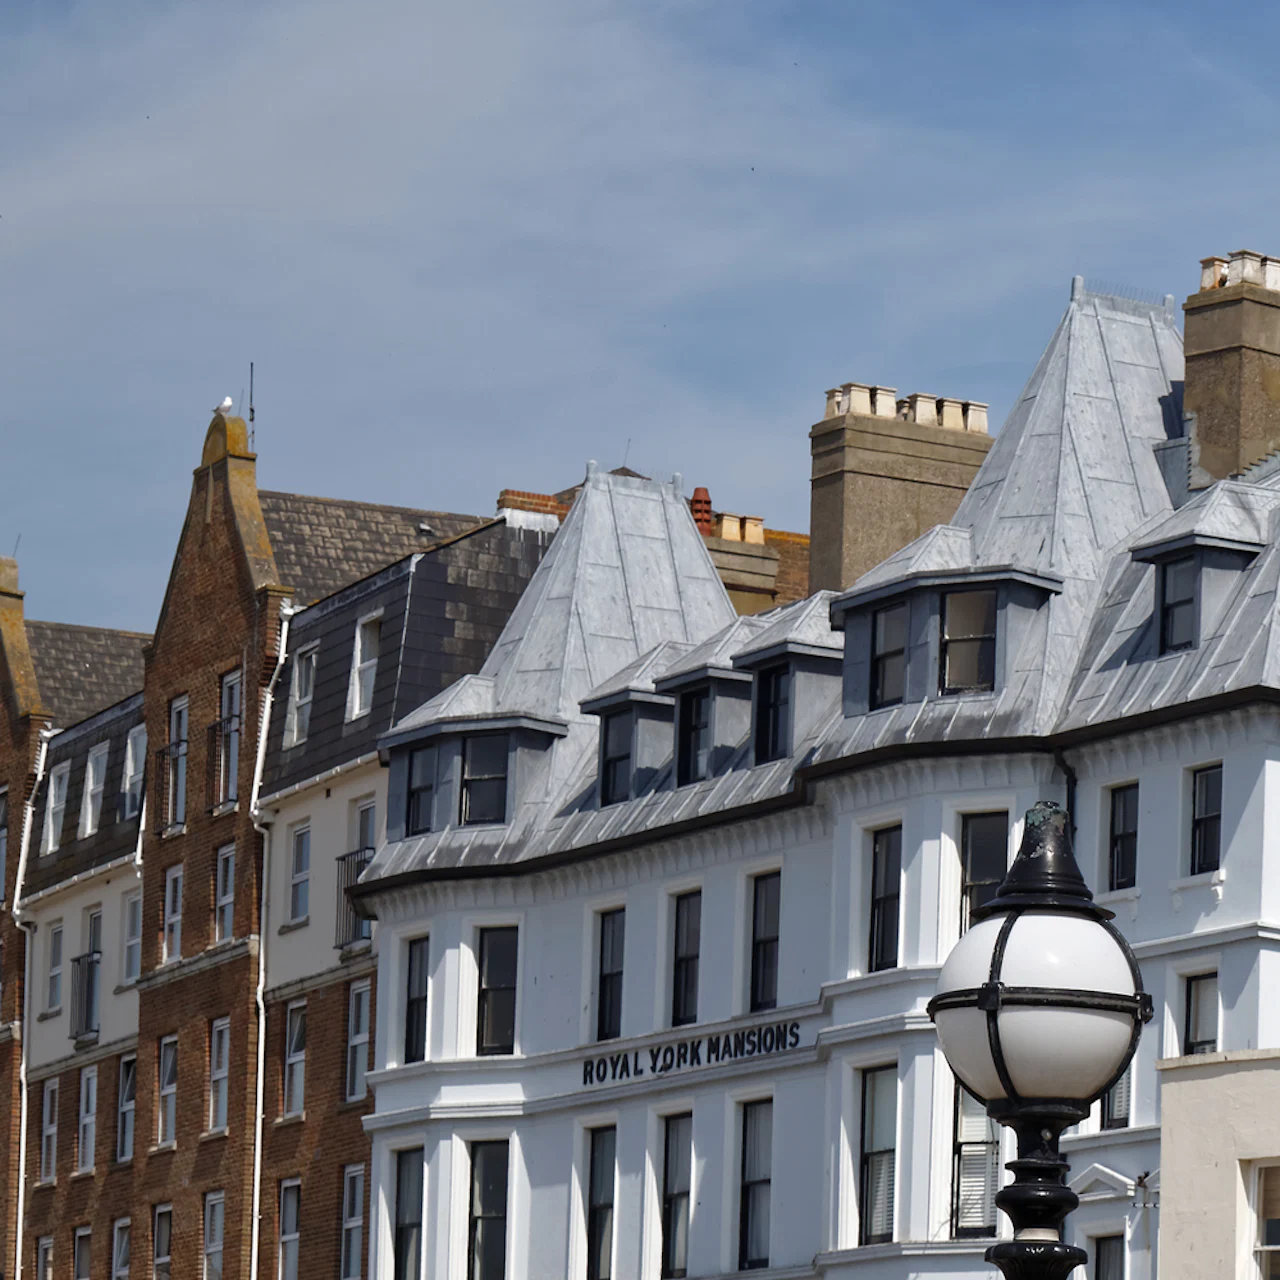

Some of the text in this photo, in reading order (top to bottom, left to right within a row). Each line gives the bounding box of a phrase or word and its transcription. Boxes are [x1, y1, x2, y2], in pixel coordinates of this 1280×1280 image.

[583, 1022, 800, 1085] ROYAL YORK MANSIONS
